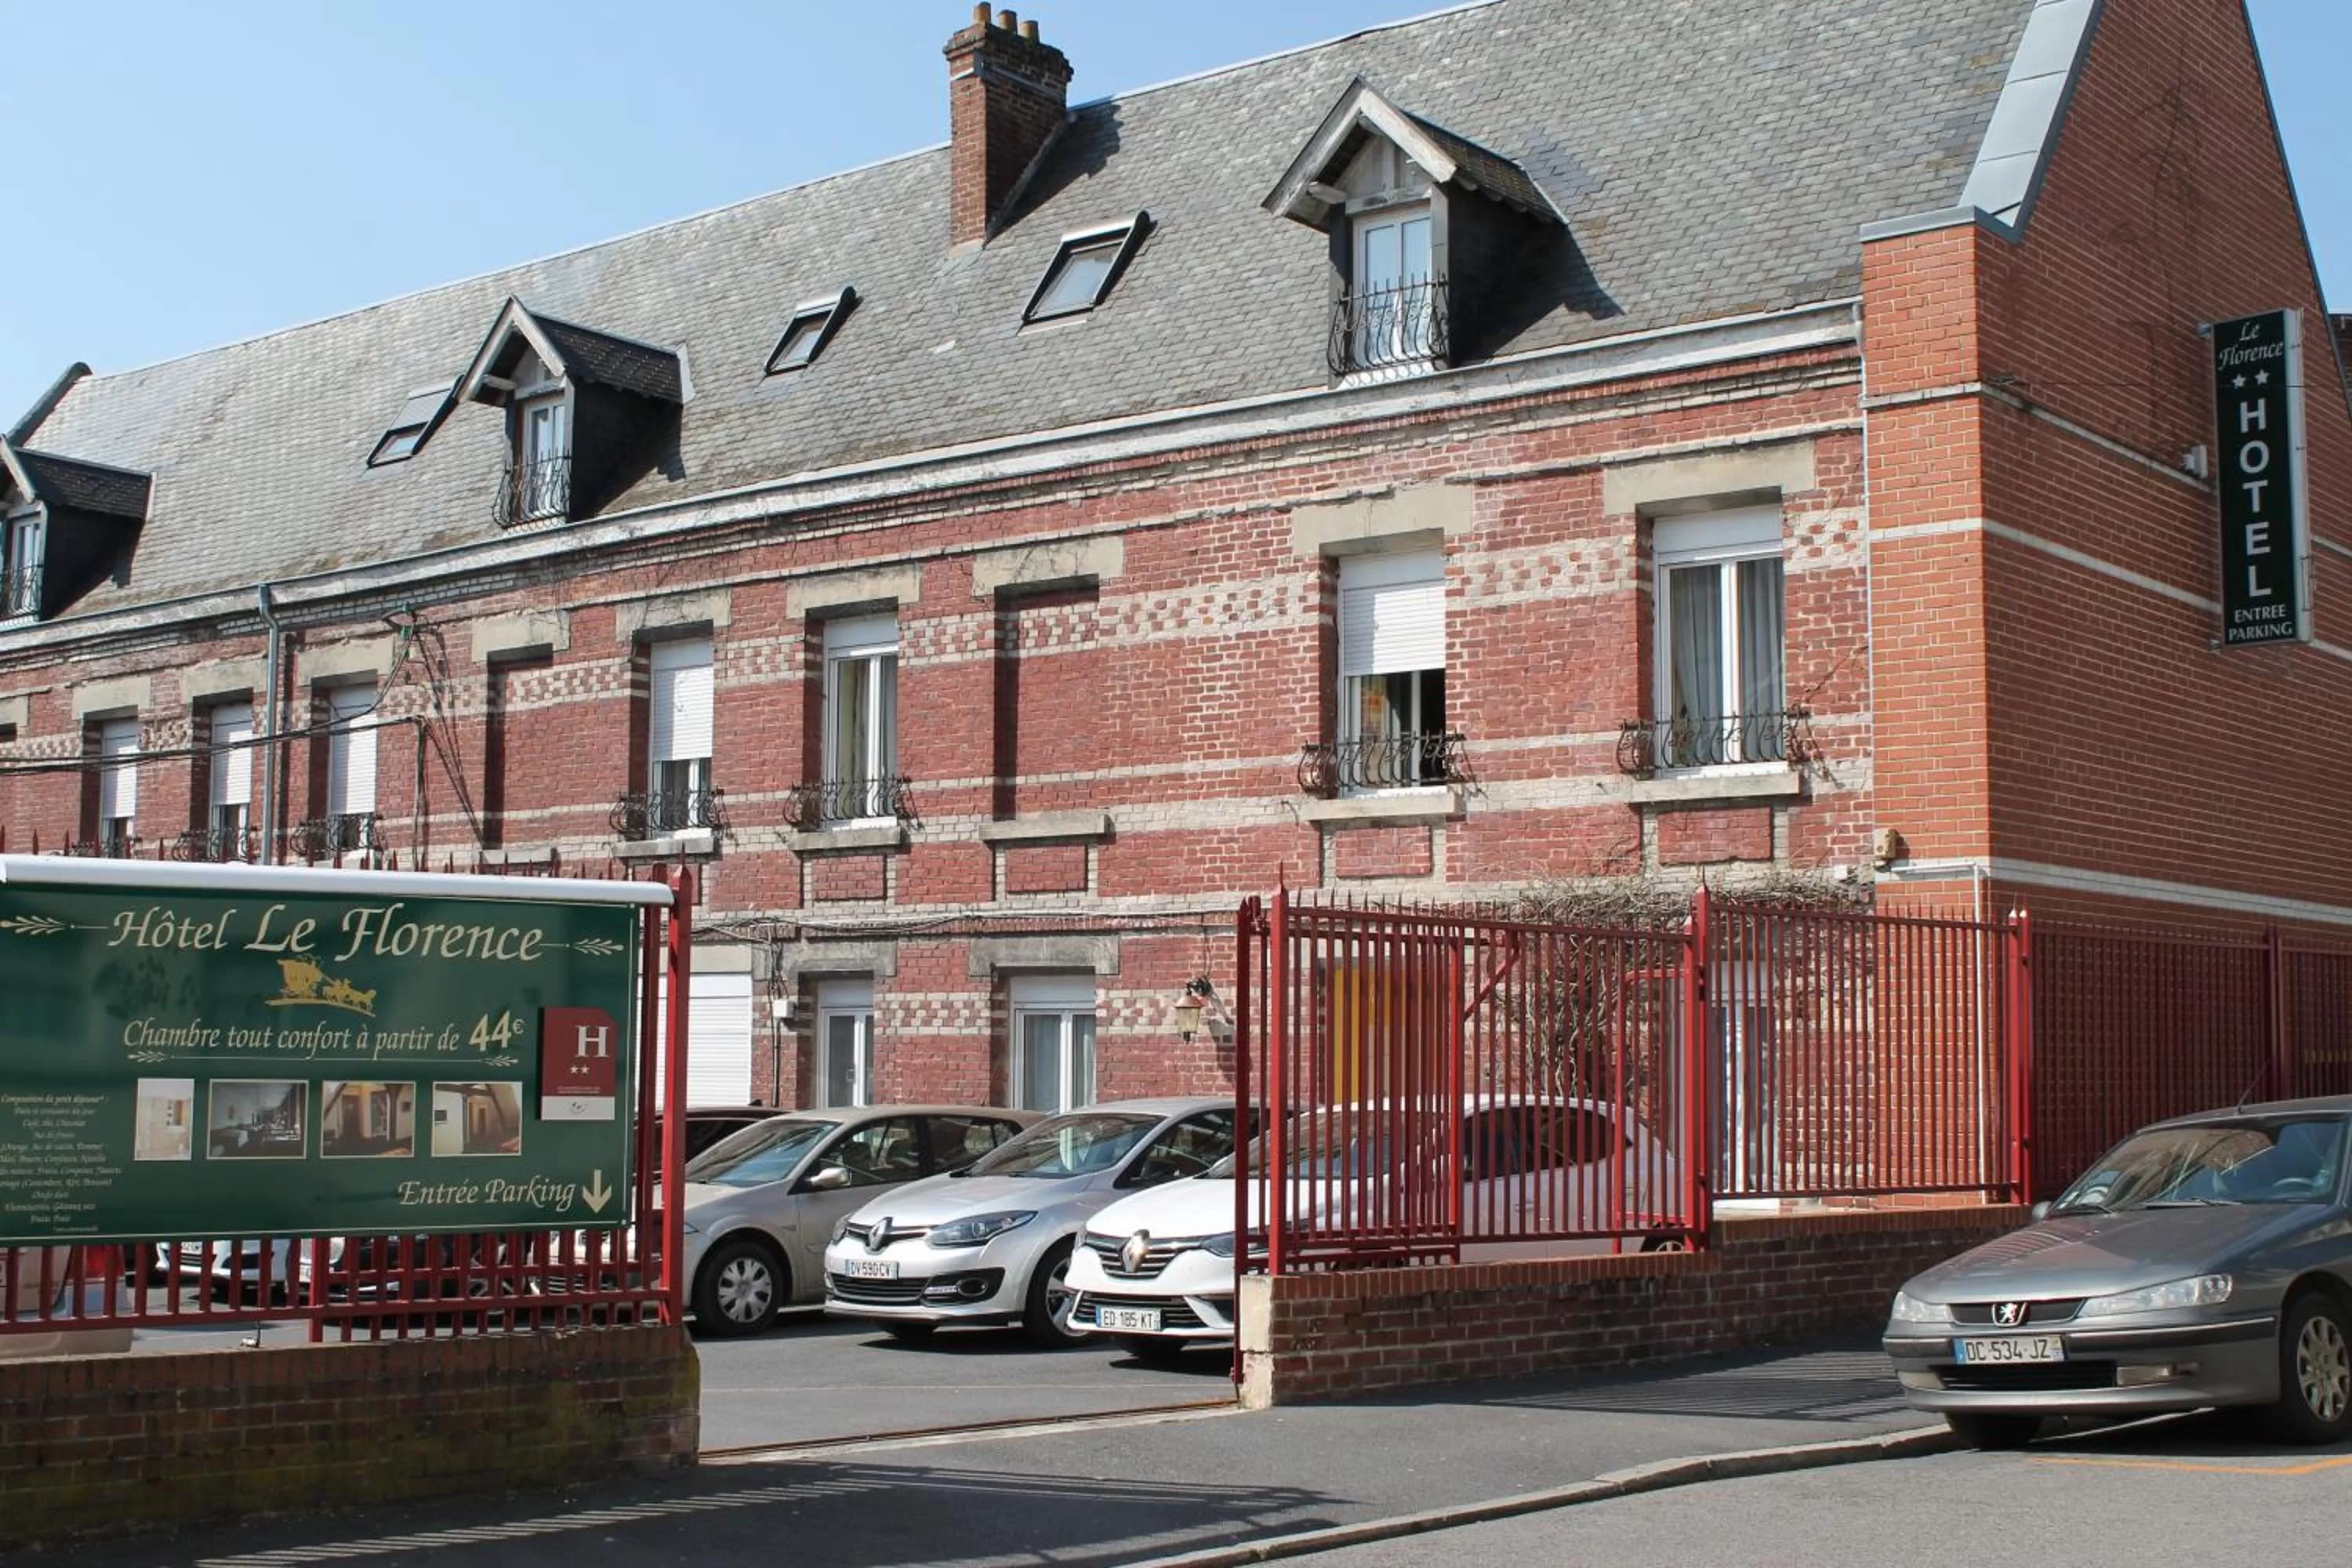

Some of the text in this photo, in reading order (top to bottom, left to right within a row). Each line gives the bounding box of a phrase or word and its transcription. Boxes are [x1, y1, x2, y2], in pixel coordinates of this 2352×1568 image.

[2239, 321, 2260, 341] Le
[2217, 341, 2284, 371] Florence
[2239, 398, 2272, 597] HOTEL
[2234, 603, 2287, 623] ENTREE
[2228, 621, 2293, 641] PARKING
[107, 902, 544, 962] Hôtel Le Florence
[124, 1017, 220, 1047] Chambre
[227, 1026, 273, 1049] tout
[278, 1020, 351, 1061] confort
[357, 1022, 368, 1049] à
[373, 1025, 434, 1061] partir
[436, 1022, 459, 1051] de
[574, 1025, 610, 1058] H
[397, 1174, 576, 1212] Entrée Parking
